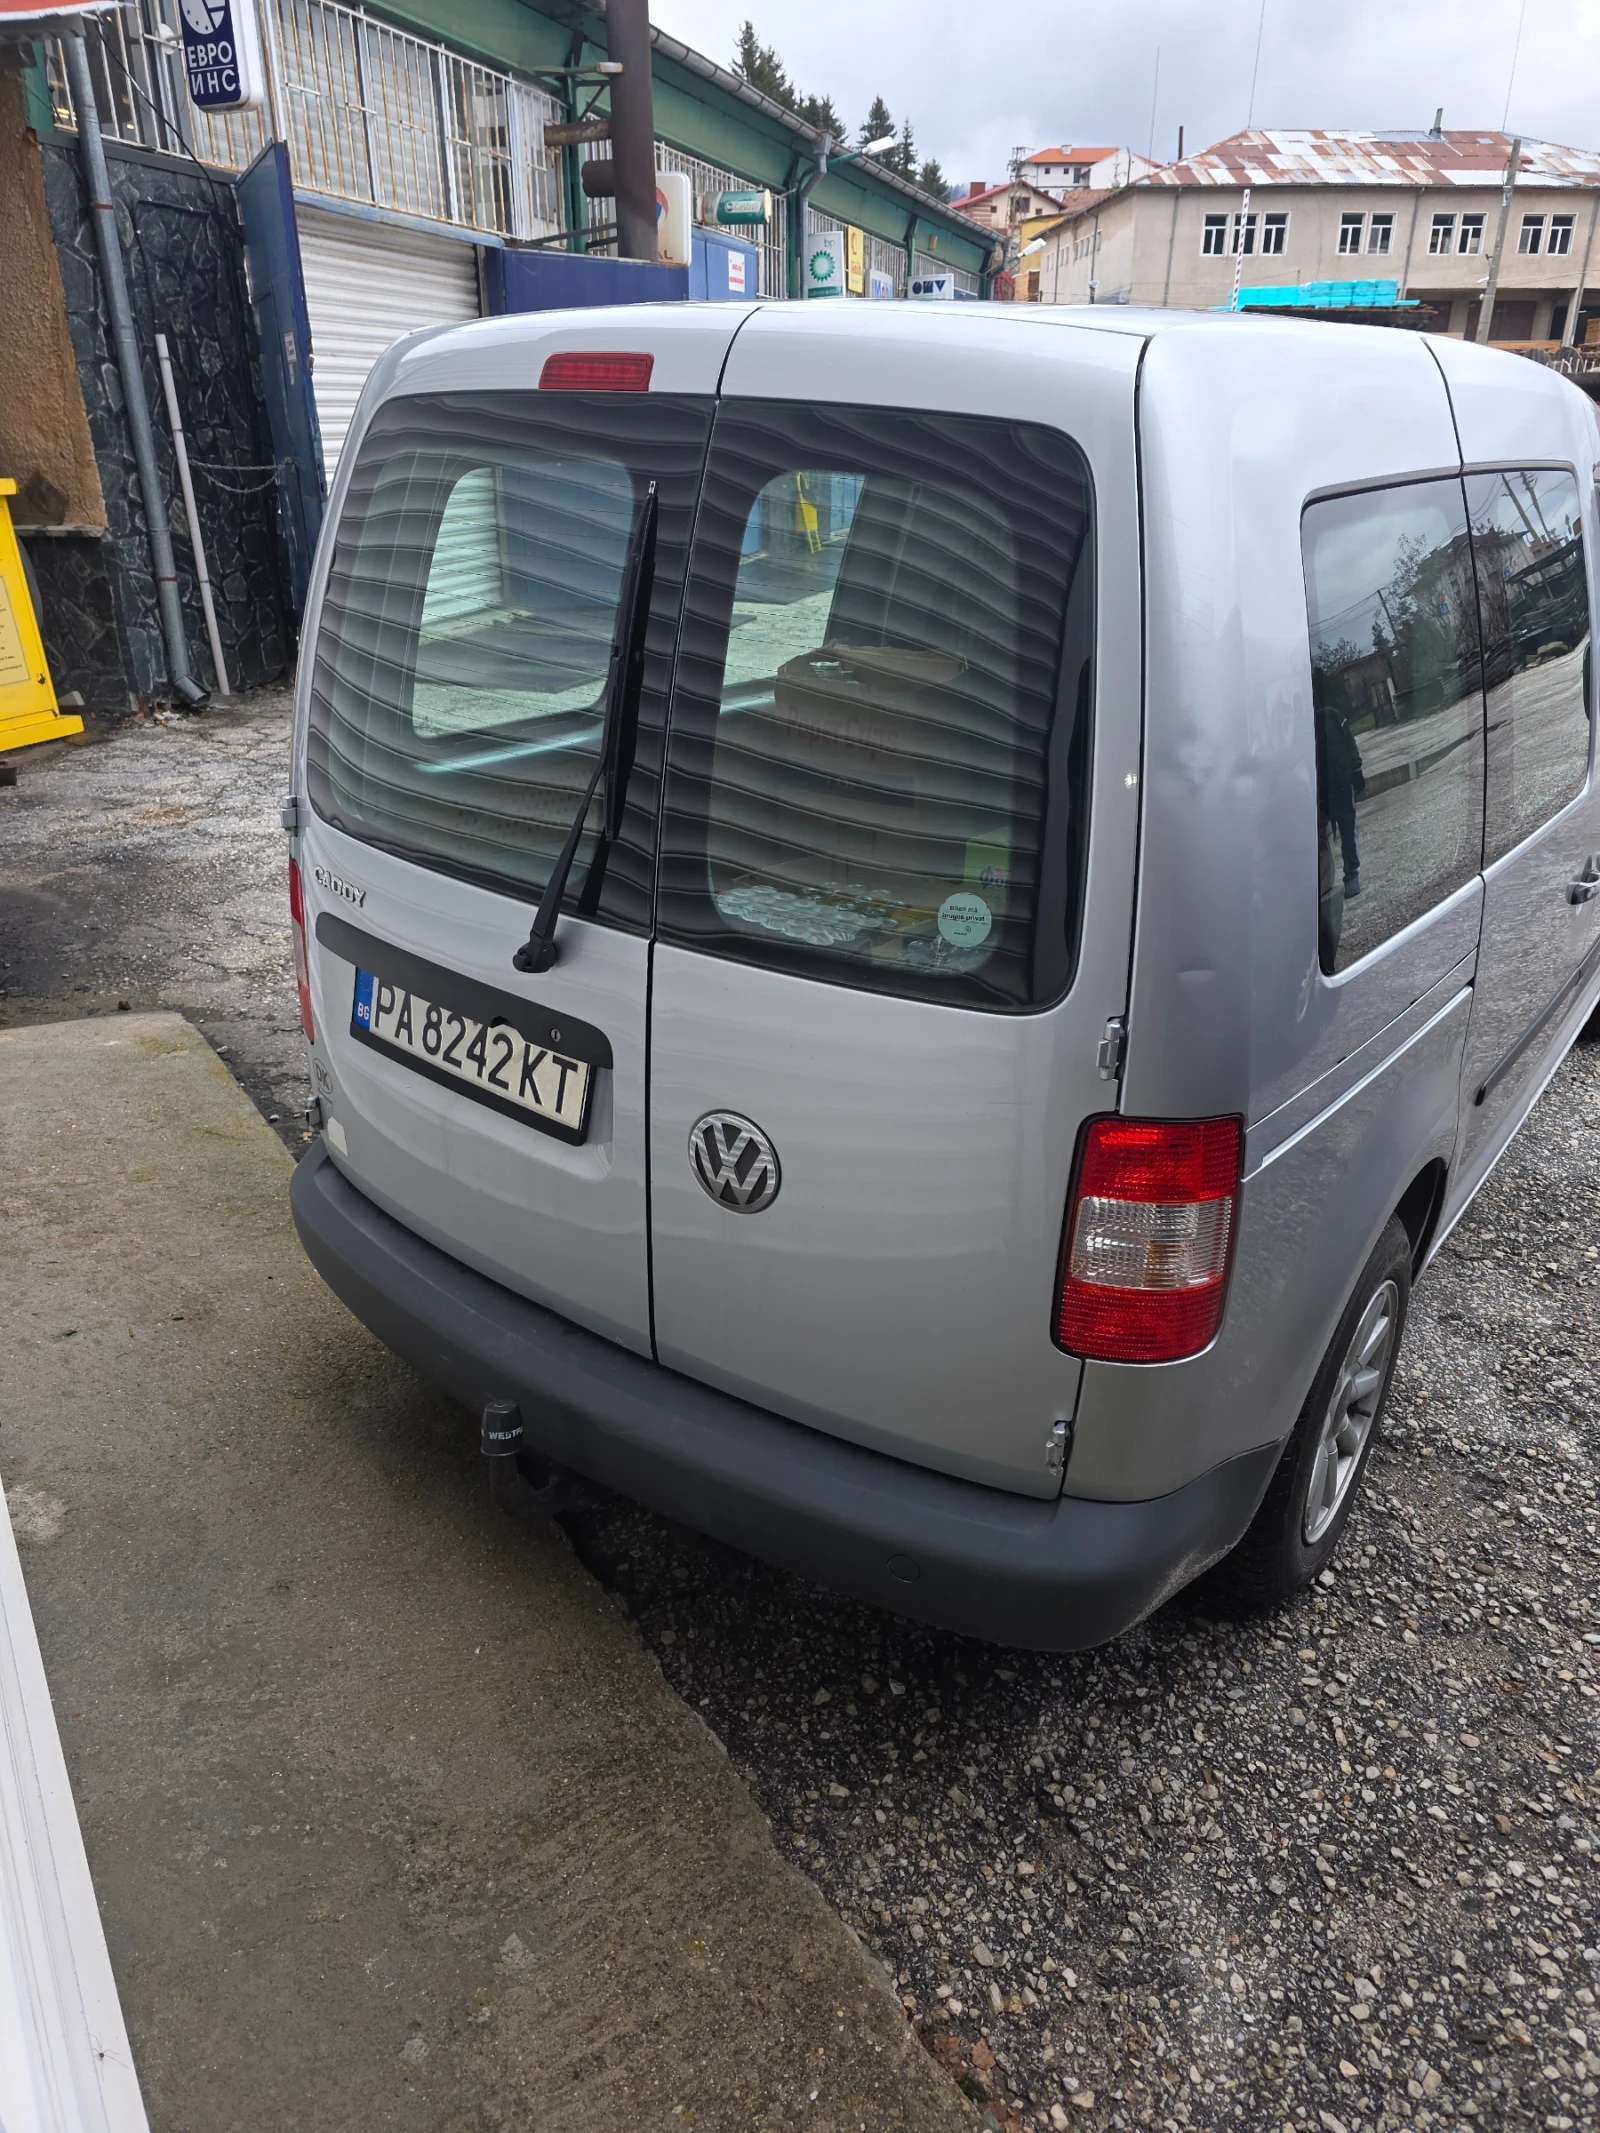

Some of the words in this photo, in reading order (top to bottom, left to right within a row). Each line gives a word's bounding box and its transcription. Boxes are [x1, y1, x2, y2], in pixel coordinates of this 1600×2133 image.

[187, 41, 232, 68] ЕВРО
[191, 69, 236, 95] ИНС
[824, 238, 836, 249] bp
[314, 864, 366, 908] CADDY
[941, 911, 964, 921] bruges
[965, 914, 985, 922] privat
[357, 1001, 370, 1021] BG
[315, 1062, 331, 1091] DK
